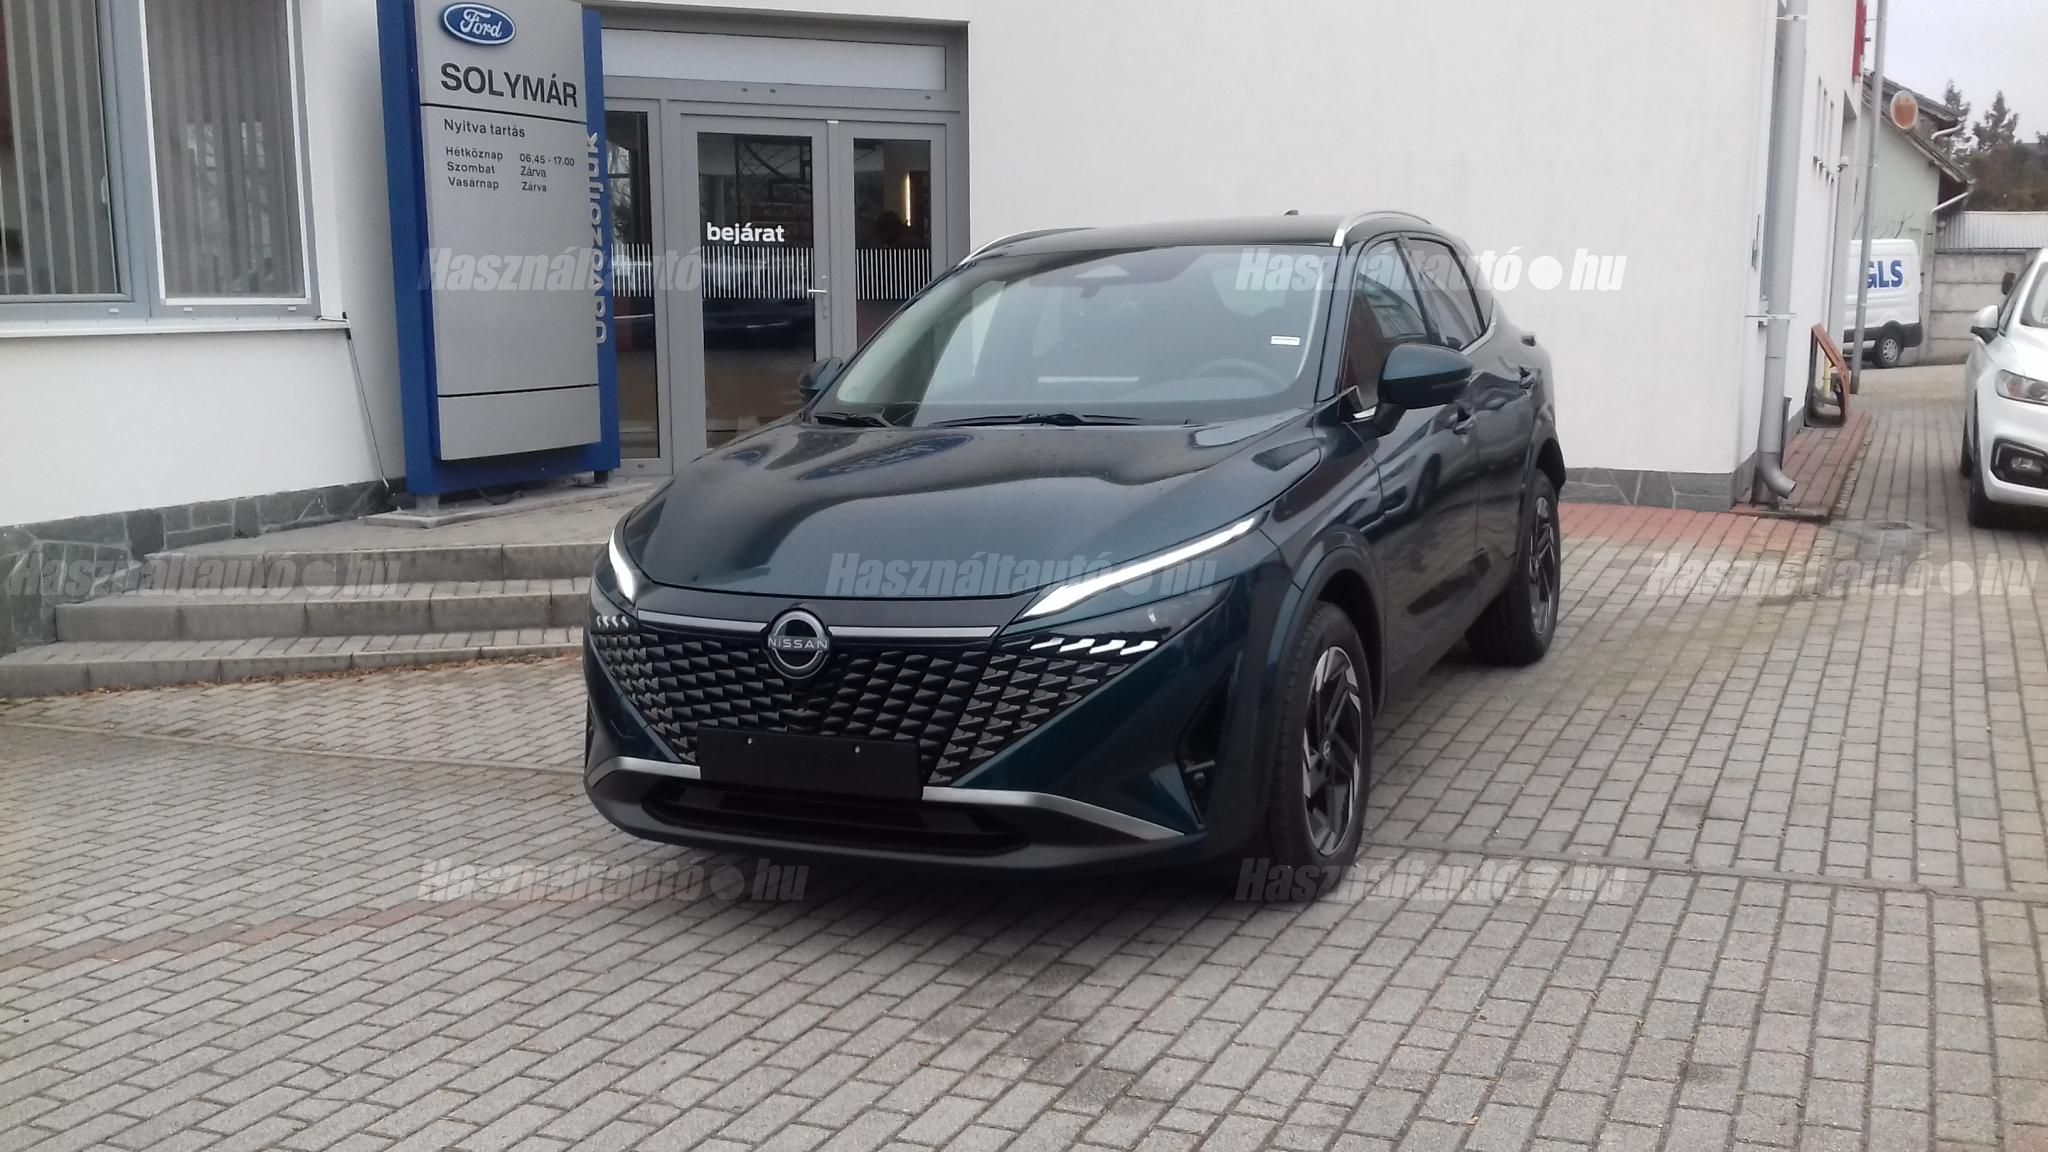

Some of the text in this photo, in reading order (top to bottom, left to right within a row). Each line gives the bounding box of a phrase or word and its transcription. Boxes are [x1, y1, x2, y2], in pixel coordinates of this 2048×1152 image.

[460, 8, 503, 38] Ford
[440, 62, 578, 108] SOLYMÁR
[443, 118, 526, 138] Nyitva tartás
[445, 145, 504, 162] Hétköznap
[519, 153, 546, 165] 06.45
[553, 156, 575, 167] 17.00
[446, 161, 547, 178] Szombat Zárva
[447, 176, 547, 192] Vasárnap Zárva
[706, 222, 785, 245] bejárat
[767, 637, 829, 649] NISSAN
